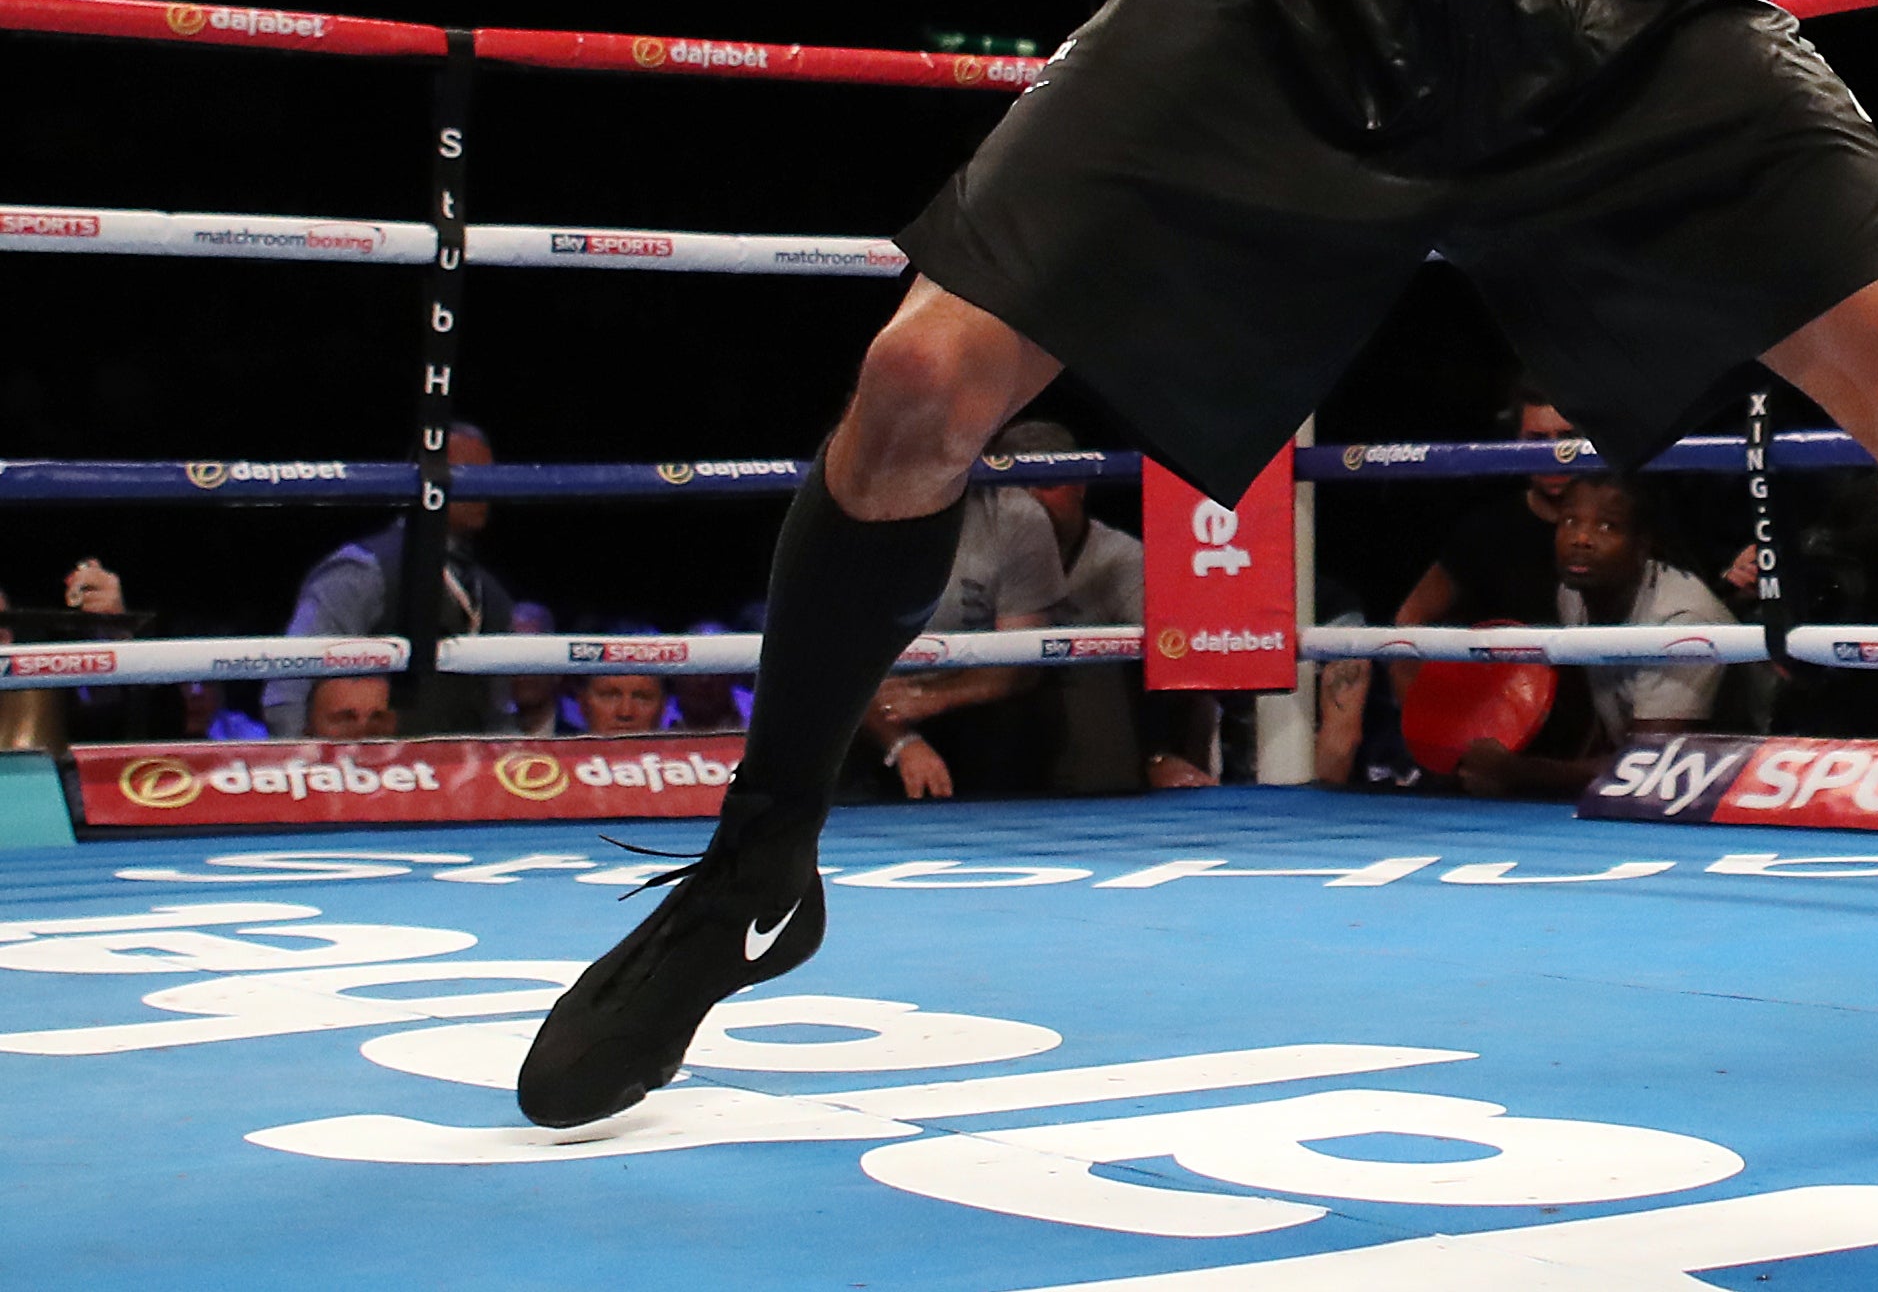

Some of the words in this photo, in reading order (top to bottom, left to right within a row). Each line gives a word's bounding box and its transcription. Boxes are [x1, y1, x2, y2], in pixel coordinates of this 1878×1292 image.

[210, 7, 326, 39] dafabet
[670, 42, 769, 70] dafabet
[195, 225, 375, 254] matchroomboxing
[551, 234, 586, 255] sky
[591, 236, 672, 257] SPORTS
[608, 643, 688, 663] SPORTS
[1190, 630, 1286, 654] dafabet
[17, 655, 113, 674] SPORTS
[210, 761, 441, 801] dafabet
[577, 752, 739, 791] dafab
[1601, 737, 1748, 816] sky
